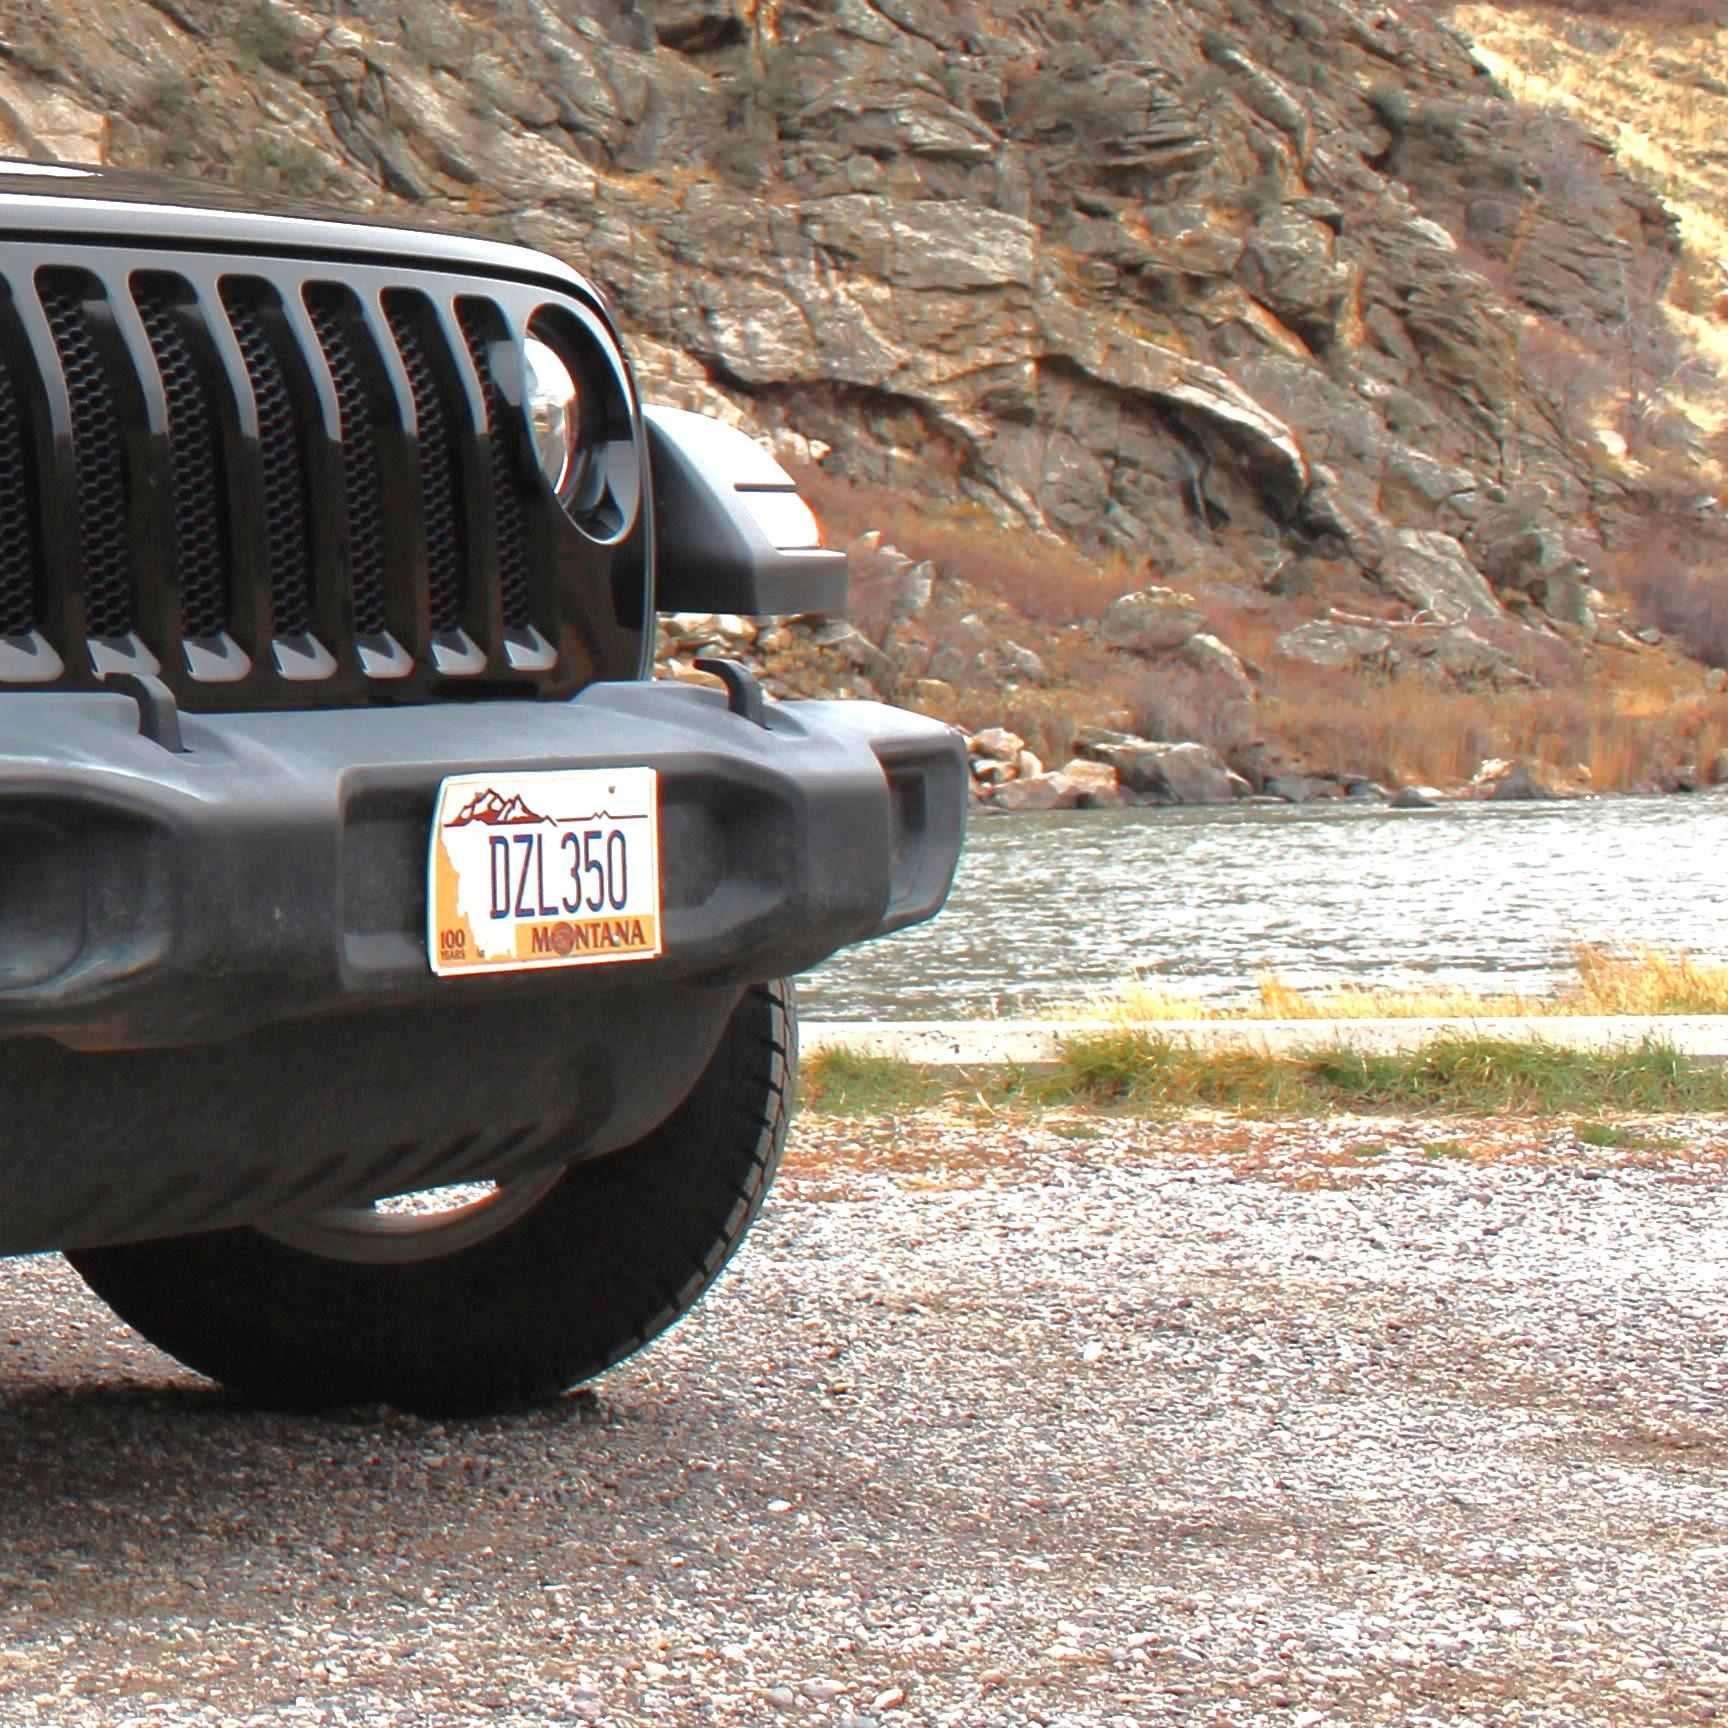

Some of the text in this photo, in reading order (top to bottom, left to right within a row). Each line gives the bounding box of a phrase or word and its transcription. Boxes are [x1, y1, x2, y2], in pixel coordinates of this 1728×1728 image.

[489, 829, 628, 920] DZL350
[440, 928, 466, 950] 100
[531, 919, 647, 957] MONTANA
[440, 949, 466, 961] YEARS
